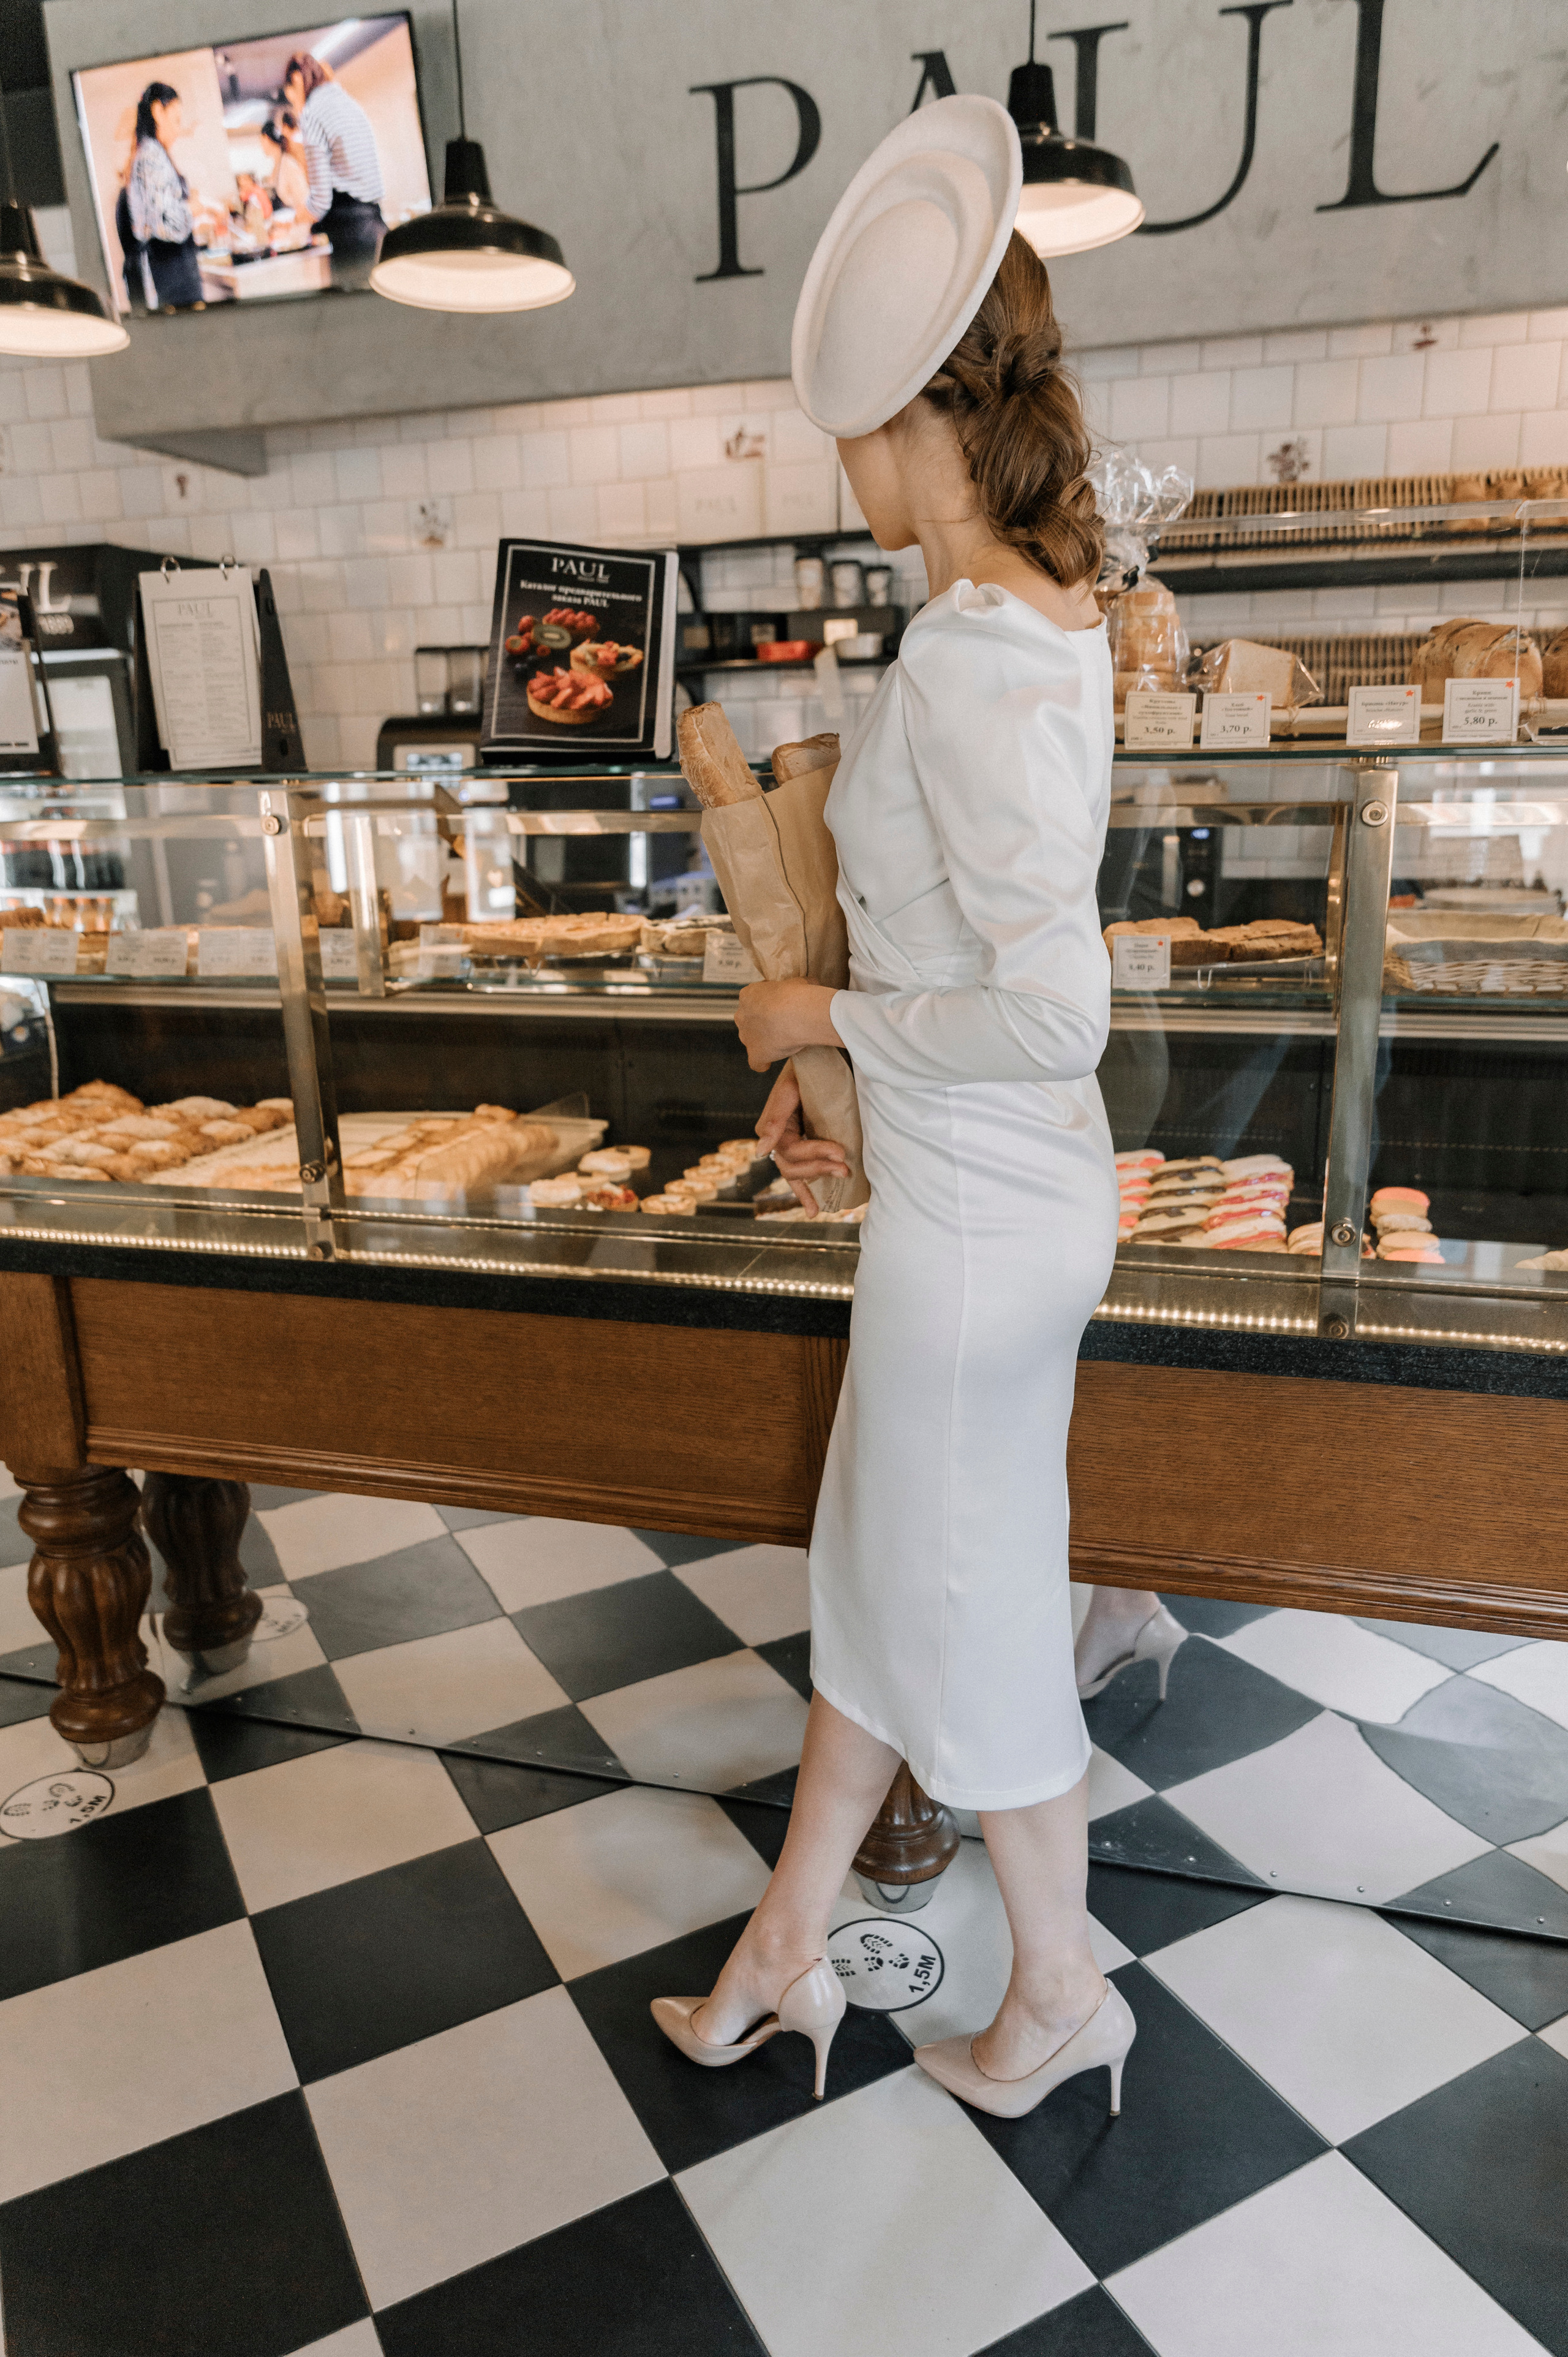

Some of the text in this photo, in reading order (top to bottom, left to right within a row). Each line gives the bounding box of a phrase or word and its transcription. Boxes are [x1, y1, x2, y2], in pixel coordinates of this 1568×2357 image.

[689, 0, 1499, 284] PUL
[552, 556, 610, 579] PAUL
[583, 596, 609, 608] PAUL
[1220, 725, 1240, 733] 3,70
[1464, 716, 1485, 725] 5,80
[908, 1954, 937, 1993] 1,5M
